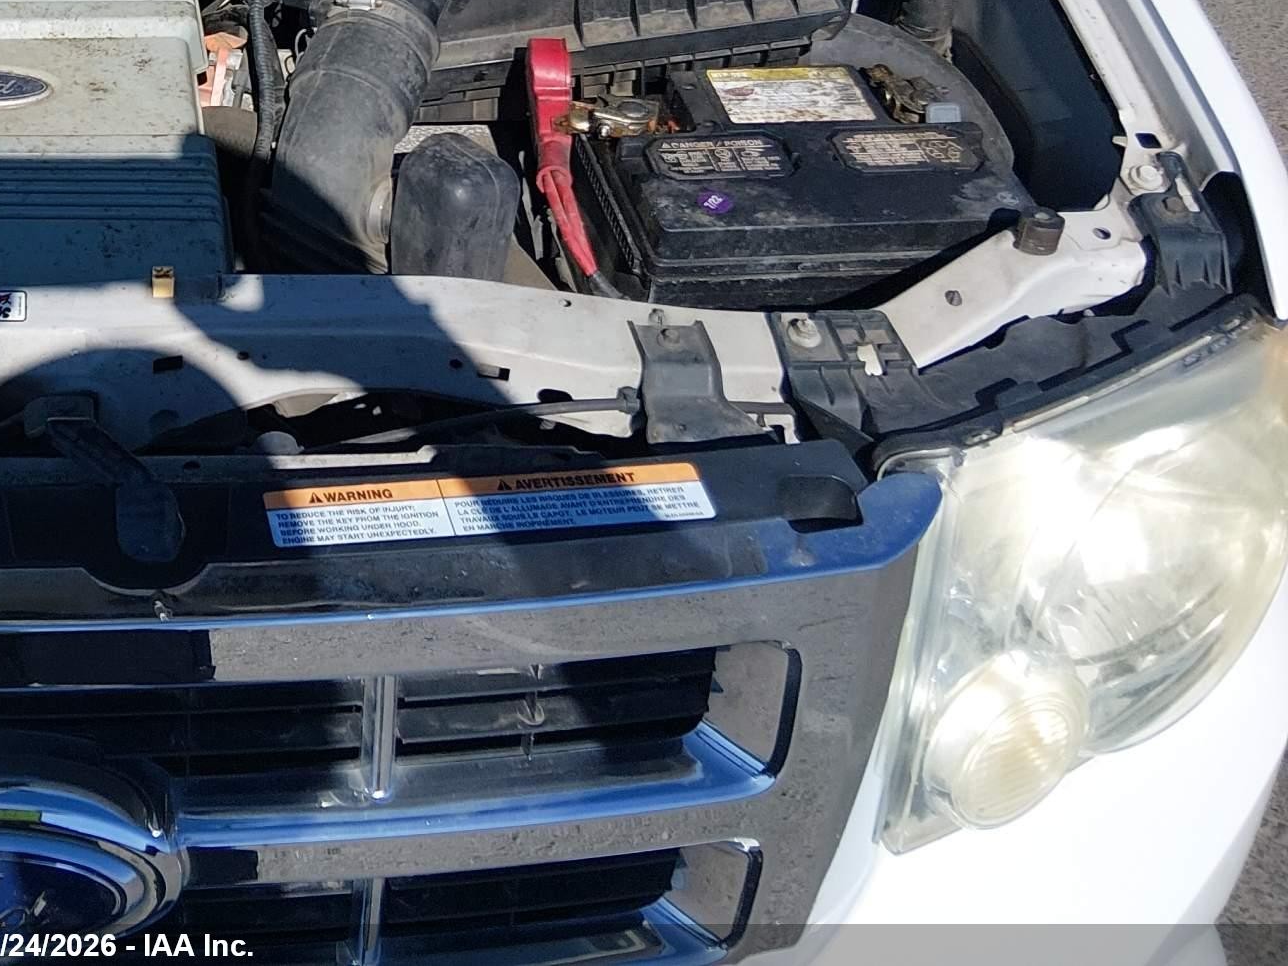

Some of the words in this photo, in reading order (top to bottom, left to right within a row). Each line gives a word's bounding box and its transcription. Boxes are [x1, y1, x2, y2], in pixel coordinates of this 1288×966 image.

[515, 472, 636, 489] AVERTISSEMENT
[323, 488, 394, 503] WARNING
[278, 520, 315, 528] REMOVE
[355, 515, 380, 523] FROM
[401, 511, 439, 520] IGNITION
[290, 511, 325, 519] REDUCE
[280, 528, 316, 536] BEFORE
[317, 525, 360, 533] WORKING
[361, 523, 391, 531] UNDER
[282, 535, 316, 544] ENGINE
[337, 532, 365, 540] START
